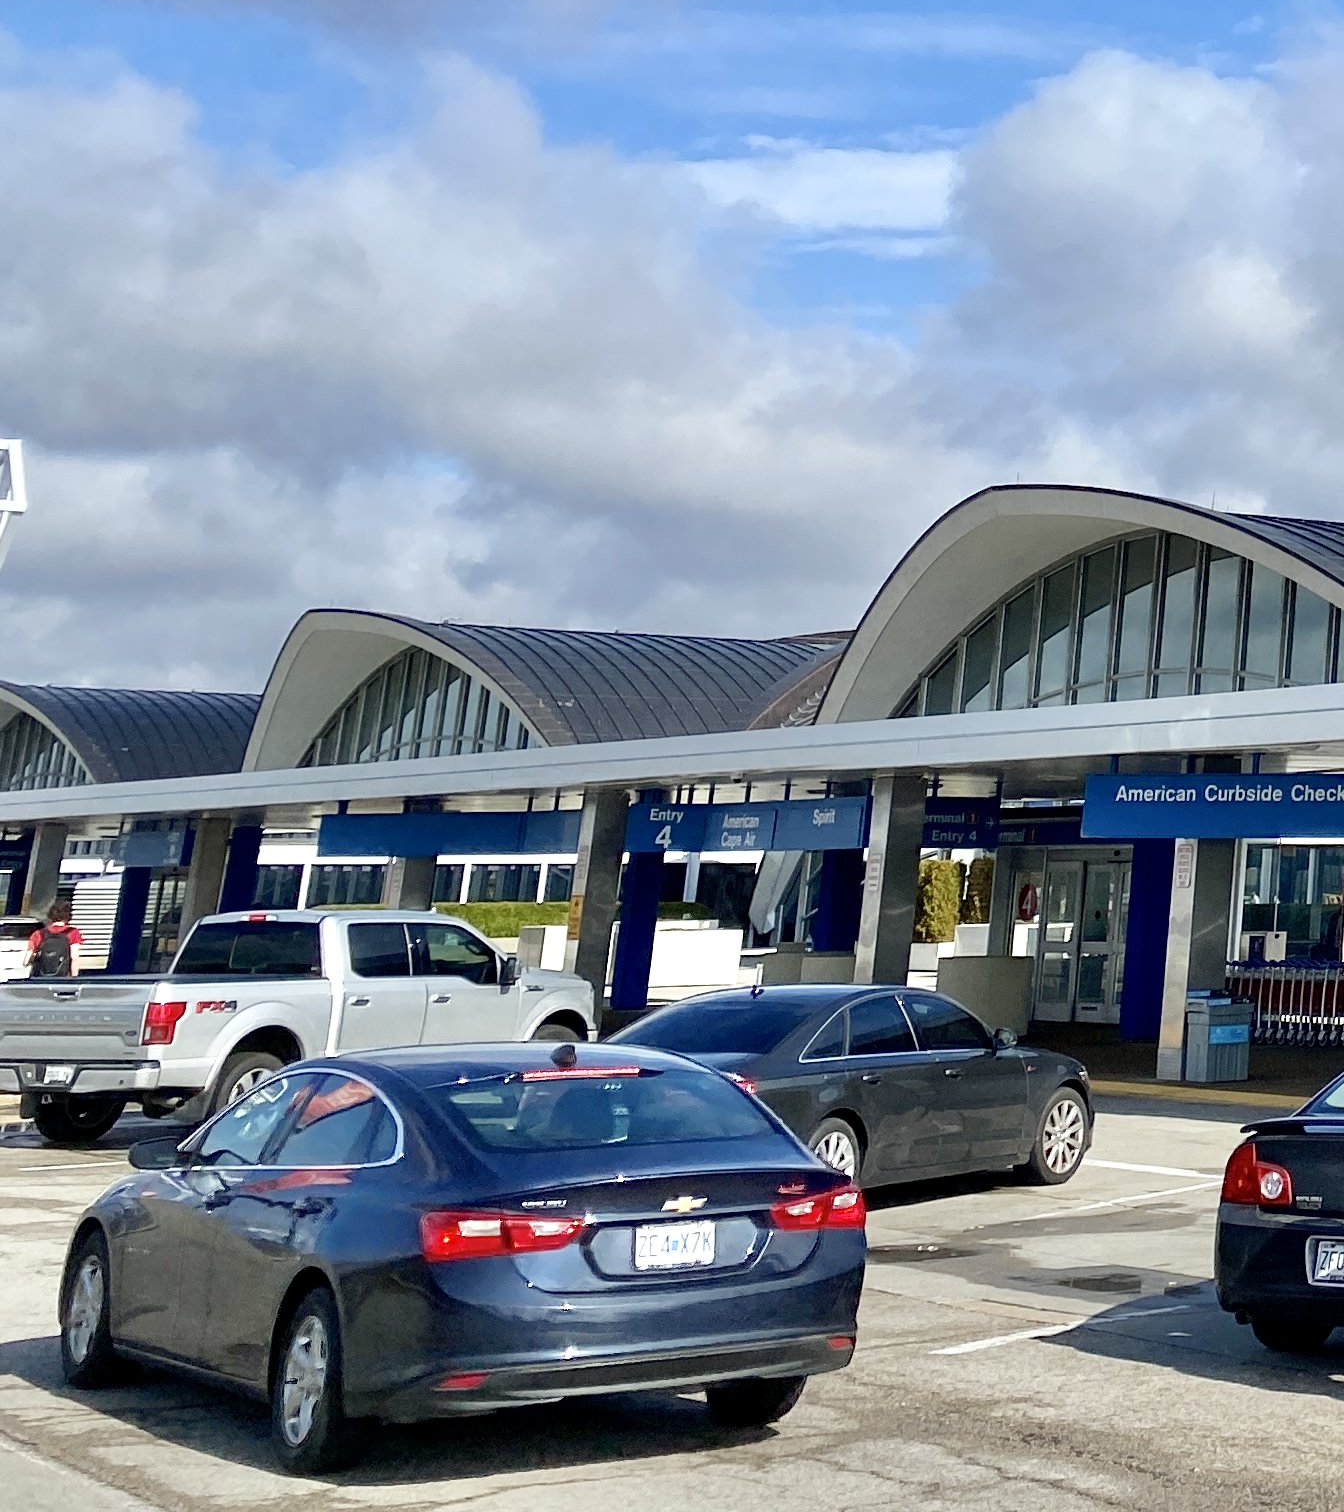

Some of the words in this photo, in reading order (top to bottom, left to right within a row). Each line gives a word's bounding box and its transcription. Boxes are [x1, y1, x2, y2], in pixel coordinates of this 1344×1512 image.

[1115, 784, 1197, 802] American
[1204, 784, 1283, 802] Curbside
[649, 808, 684, 823] Entry
[722, 813, 760, 829] American
[812, 808, 836, 827] Spirit
[654, 825, 672, 849] 4
[721, 832, 742, 849] Cape
[743, 832, 756, 847] Air
[932, 830, 964, 843] Entry
[968, 830, 977, 842] 4
[1021, 888, 1032, 911] 4
[195, 1000, 237, 1014] FX4
